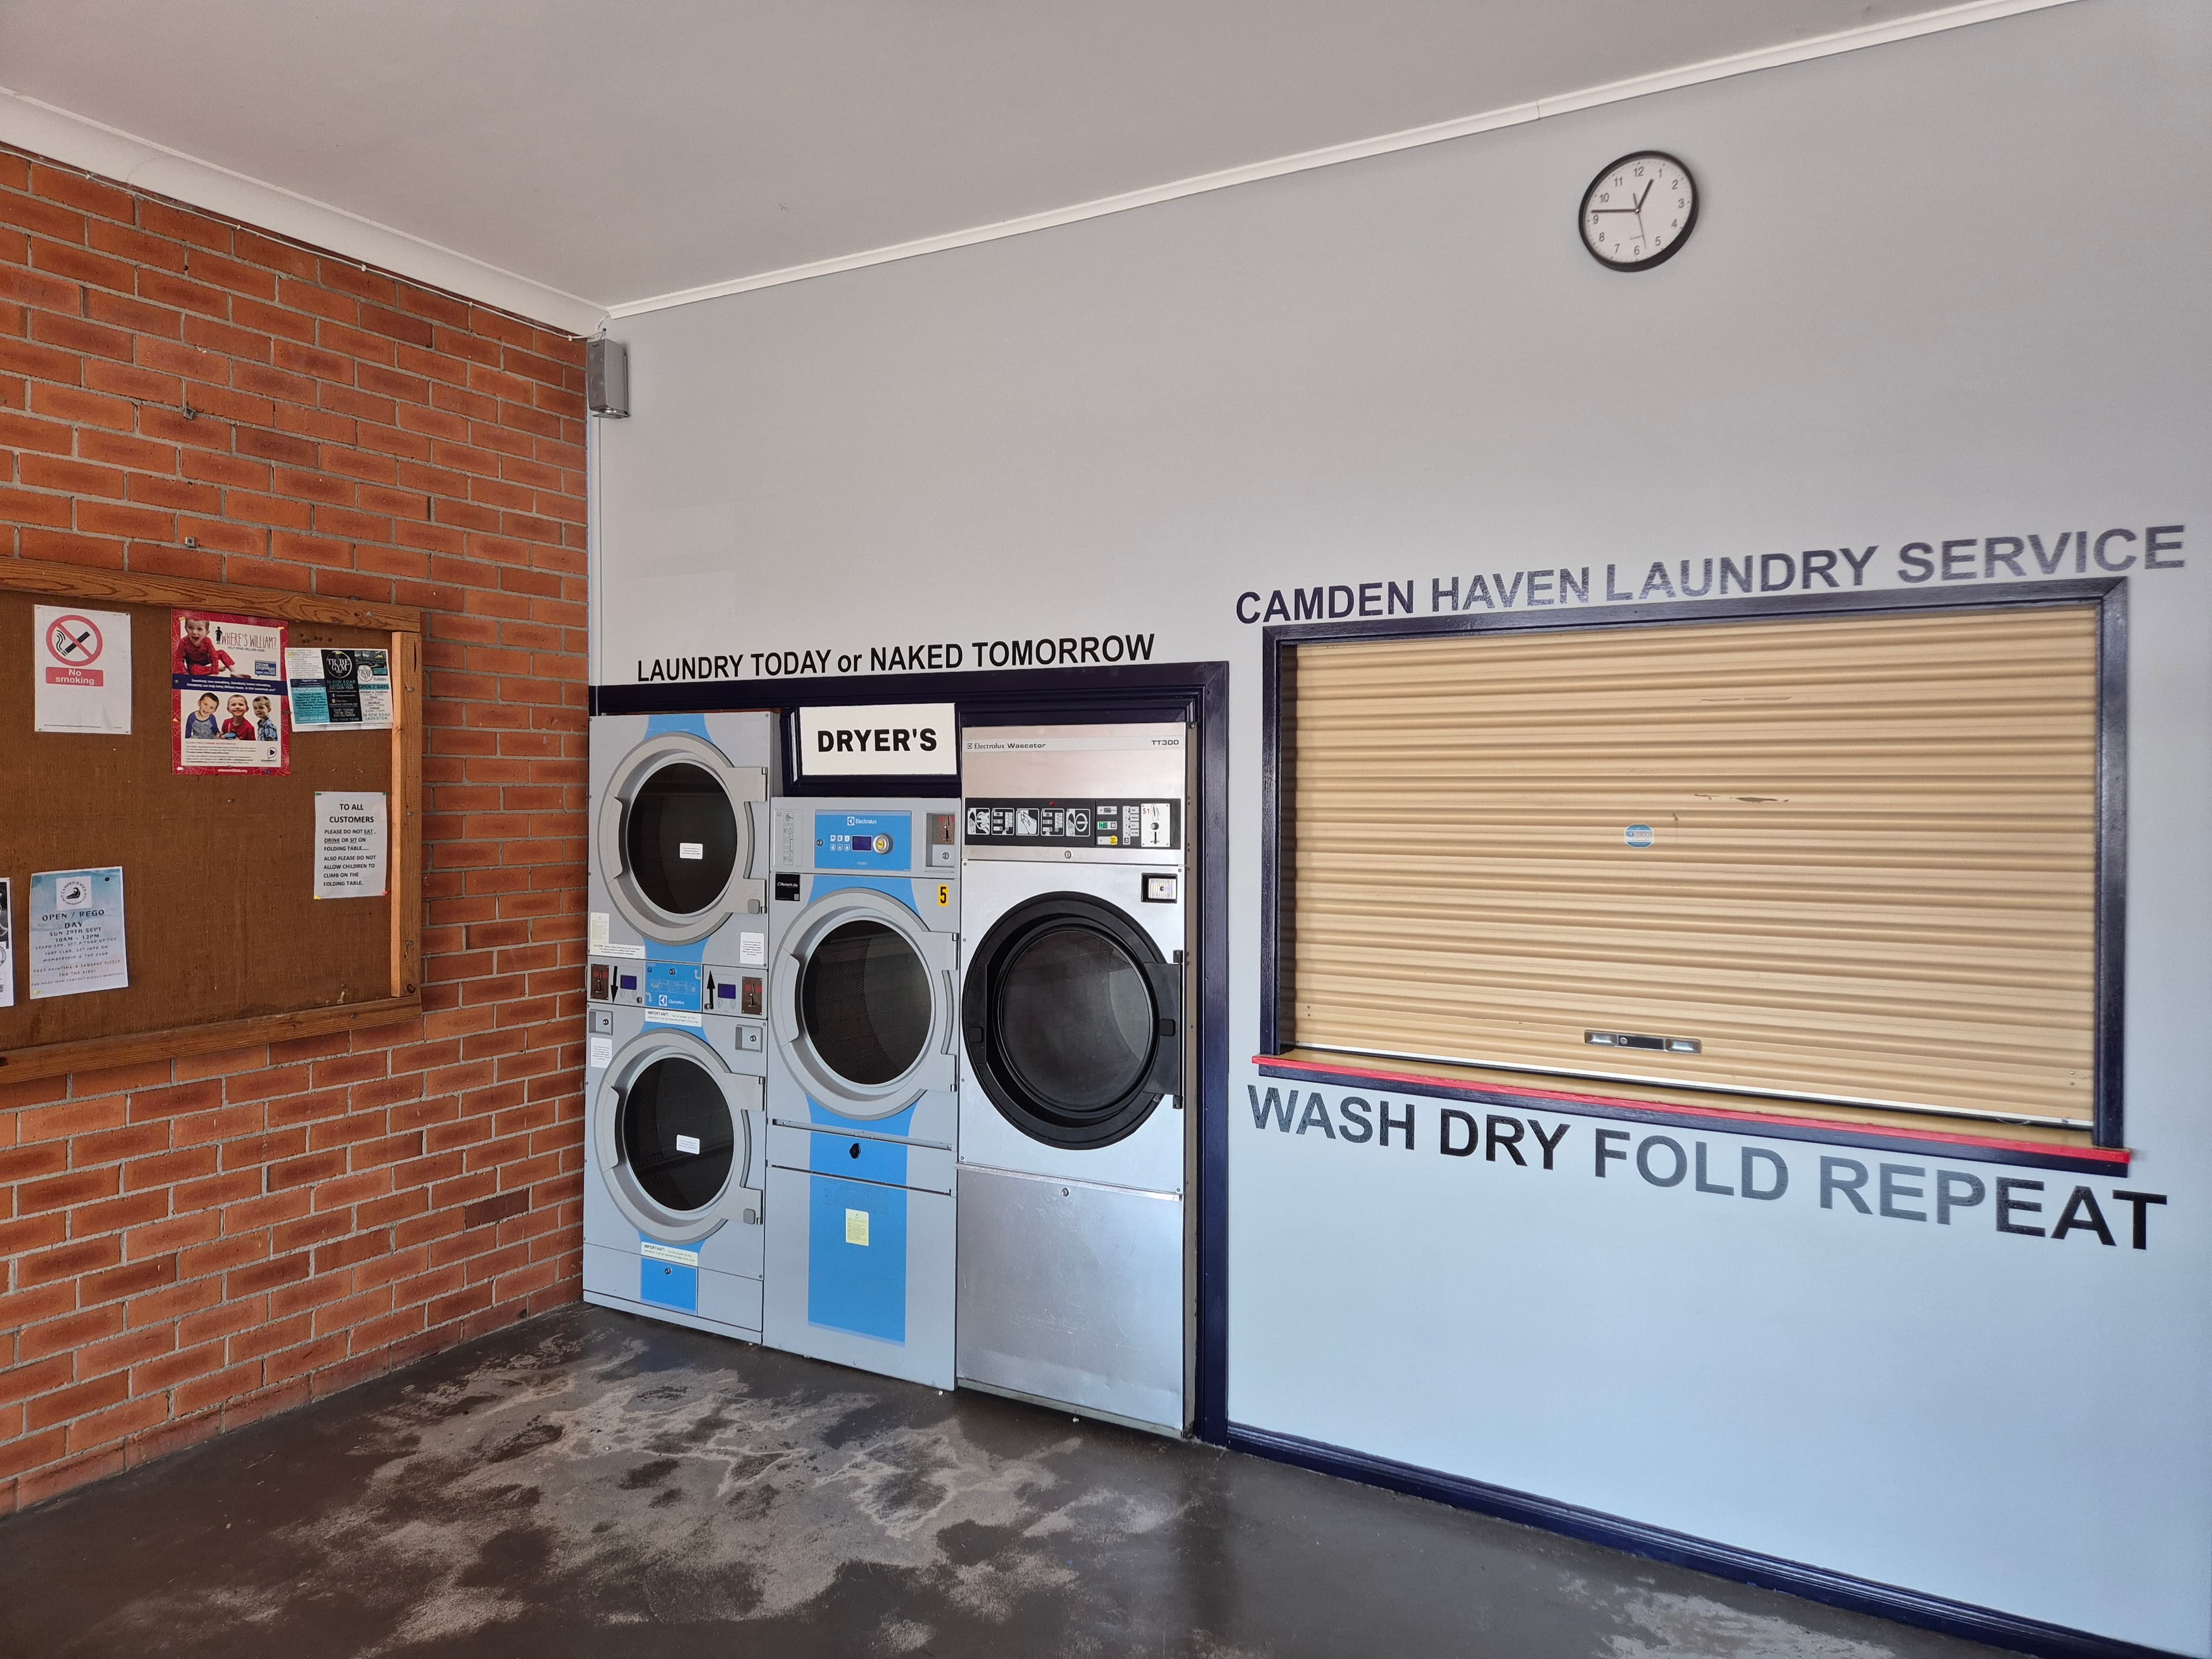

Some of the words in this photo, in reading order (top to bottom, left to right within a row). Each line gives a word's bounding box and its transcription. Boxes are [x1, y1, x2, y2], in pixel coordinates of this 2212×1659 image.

[1633, 166, 1644, 177] 12
[1658, 168, 1662, 178] 1
[1614, 177, 1623, 187] 11
[1672, 179, 1678, 190] 2
[1600, 193, 1609, 203] 10
[1678, 198, 1684, 209] 3
[1593, 214, 1599, 225] 9
[1671, 219, 1677, 228] 4
[1599, 232, 1605, 242] 8
[1655, 236, 1661, 246] 5
[1615, 244, 1620, 253] 7
[1634, 245, 1640, 255] 6
[1236, 580, 1414, 624] CAMDEN
[1432, 566, 1590, 612] HAVEN
[1606, 545, 1879, 601] LAUNDRY
[1897, 524, 2185, 583] SERVICE
[221, 632, 248, 646] WHERE'S
[249, 635, 276, 649] WILLIAM?
[638, 654, 744, 682] LAUNDRY
[751, 649, 832, 676] TODAY
[838, 654, 862, 673] or
[870, 643, 963, 671] NAKED
[972, 633, 1155, 667] TOMORROW
[55, 676, 94, 685] smoking
[817, 728, 937, 752] DRYER'S
[940, 886, 947, 904] 5
[42, 913, 67, 922] OPEN
[79, 910, 105, 918] REGO
[1247, 1084, 1415, 1150] WASH
[1440, 1108, 1571, 1171] DRY
[1595, 1128, 1789, 1201] FOLD
[1820, 1155, 2168, 1250] REPEAT
